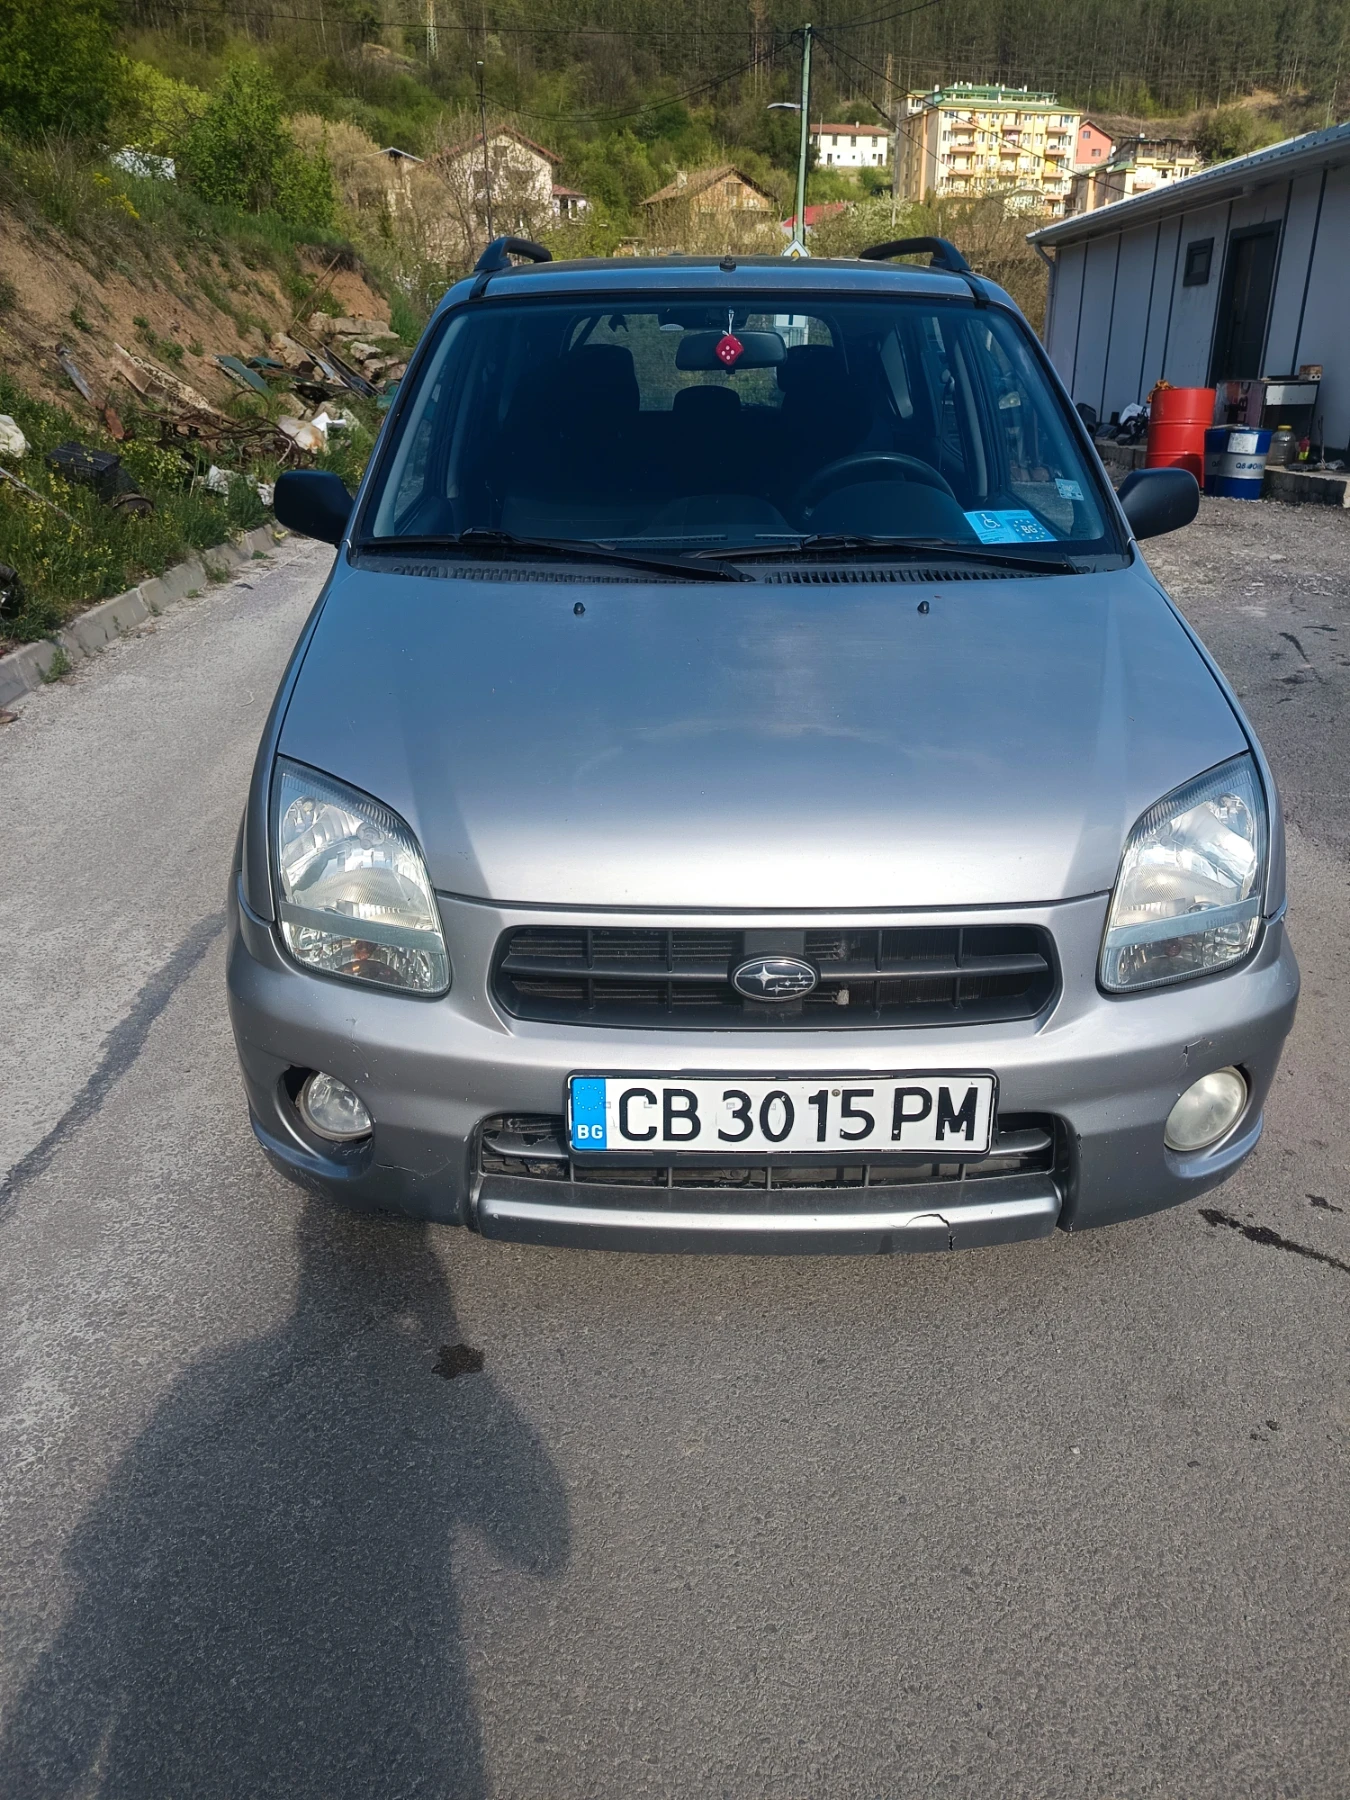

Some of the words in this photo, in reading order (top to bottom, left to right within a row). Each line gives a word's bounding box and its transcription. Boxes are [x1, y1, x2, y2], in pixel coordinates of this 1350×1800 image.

[1020, 525, 1038, 534] BG
[618, 1087, 701, 1142] CB
[717, 1088, 875, 1143] 3015
[890, 1086, 979, 1142] PM
[577, 1123, 603, 1140] BG
